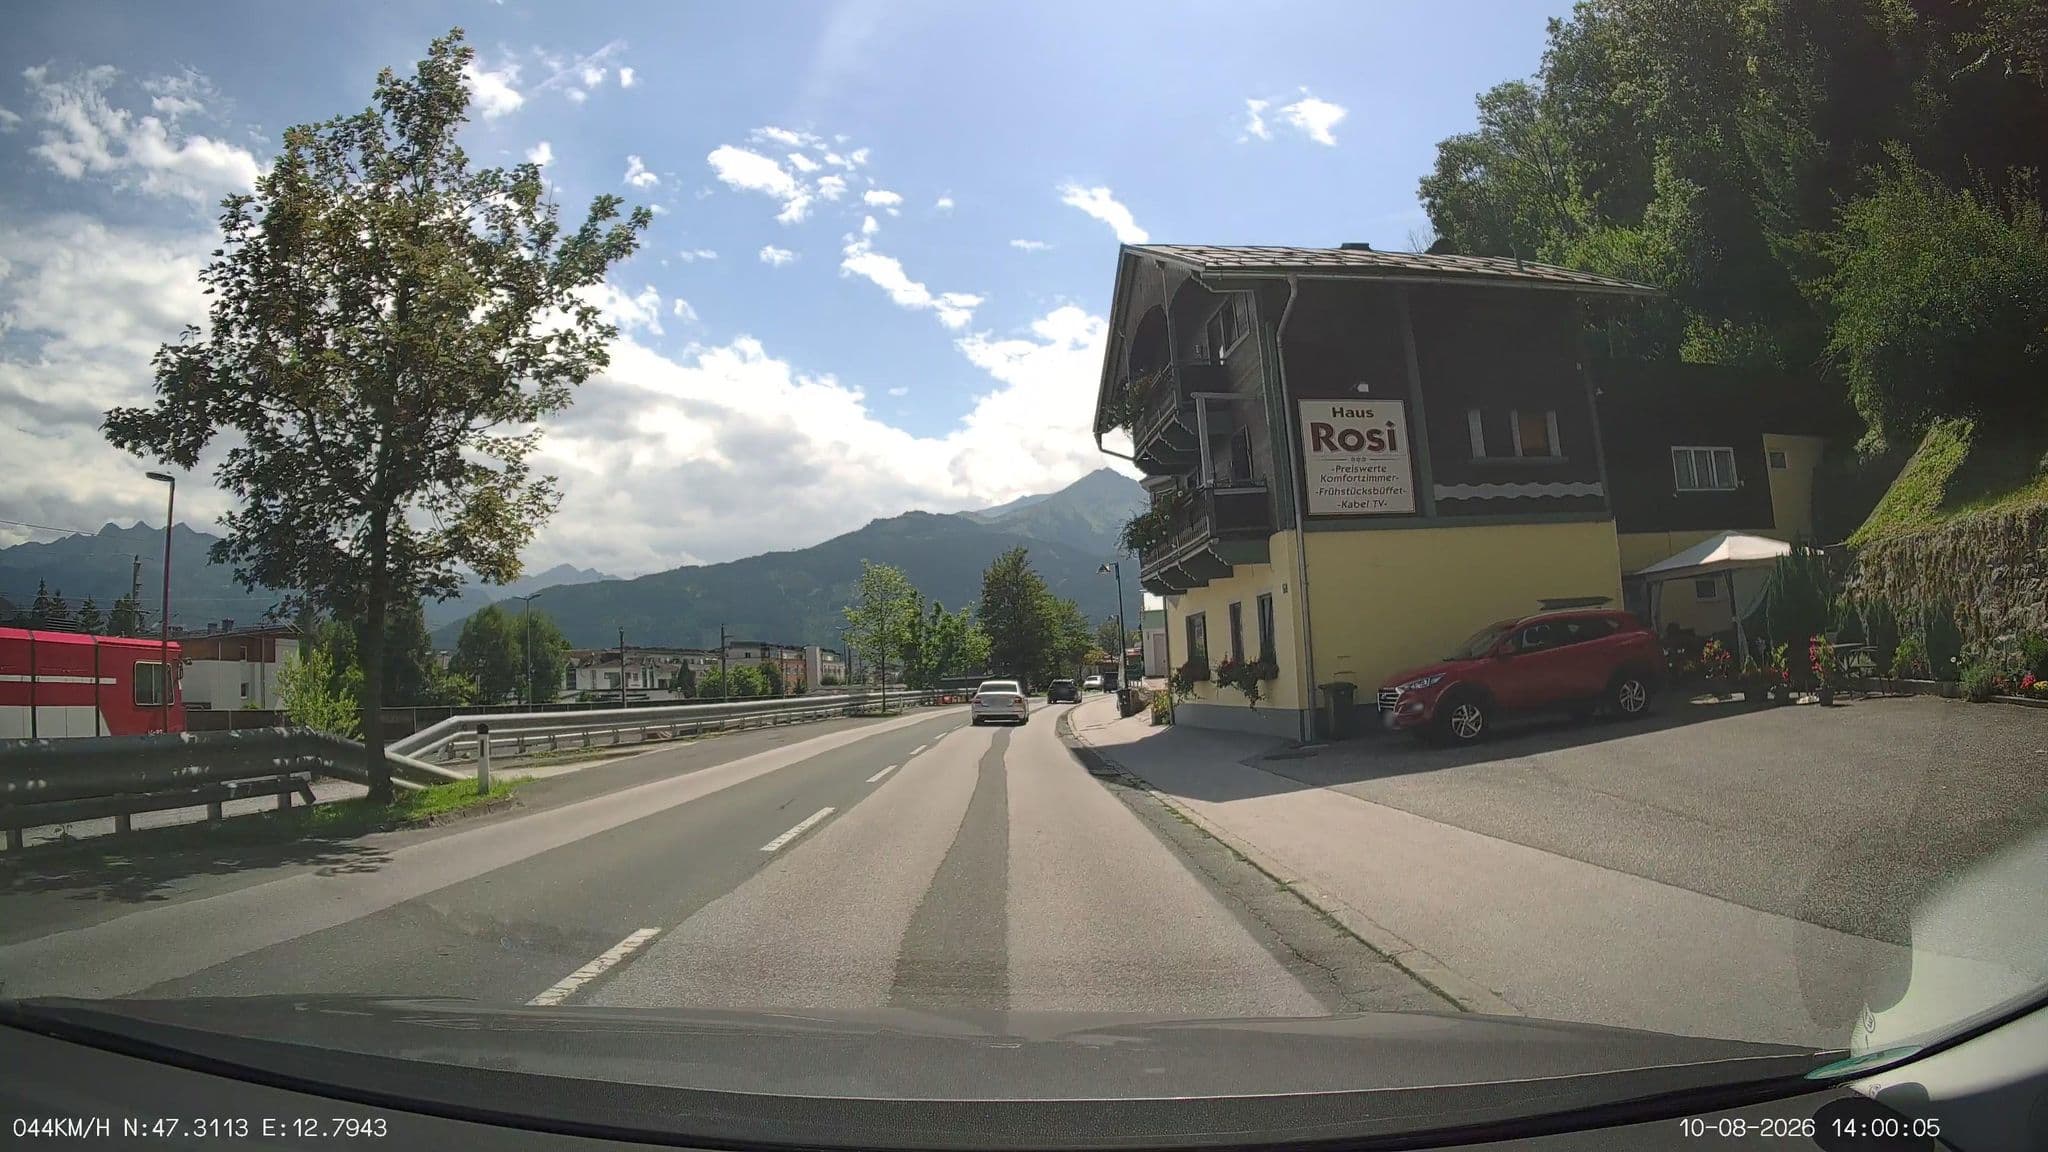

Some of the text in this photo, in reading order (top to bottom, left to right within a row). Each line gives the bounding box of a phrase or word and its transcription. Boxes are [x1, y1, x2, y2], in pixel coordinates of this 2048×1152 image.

[1332, 407, 1375, 418] Haus
[1310, 420, 1397, 451] Rosi
[1331, 464, 1387, 473] -Preiswerte
[1320, 474, 1399, 483] Komfortzimmer-
[1337, 499, 1370, 509] -Kabel
